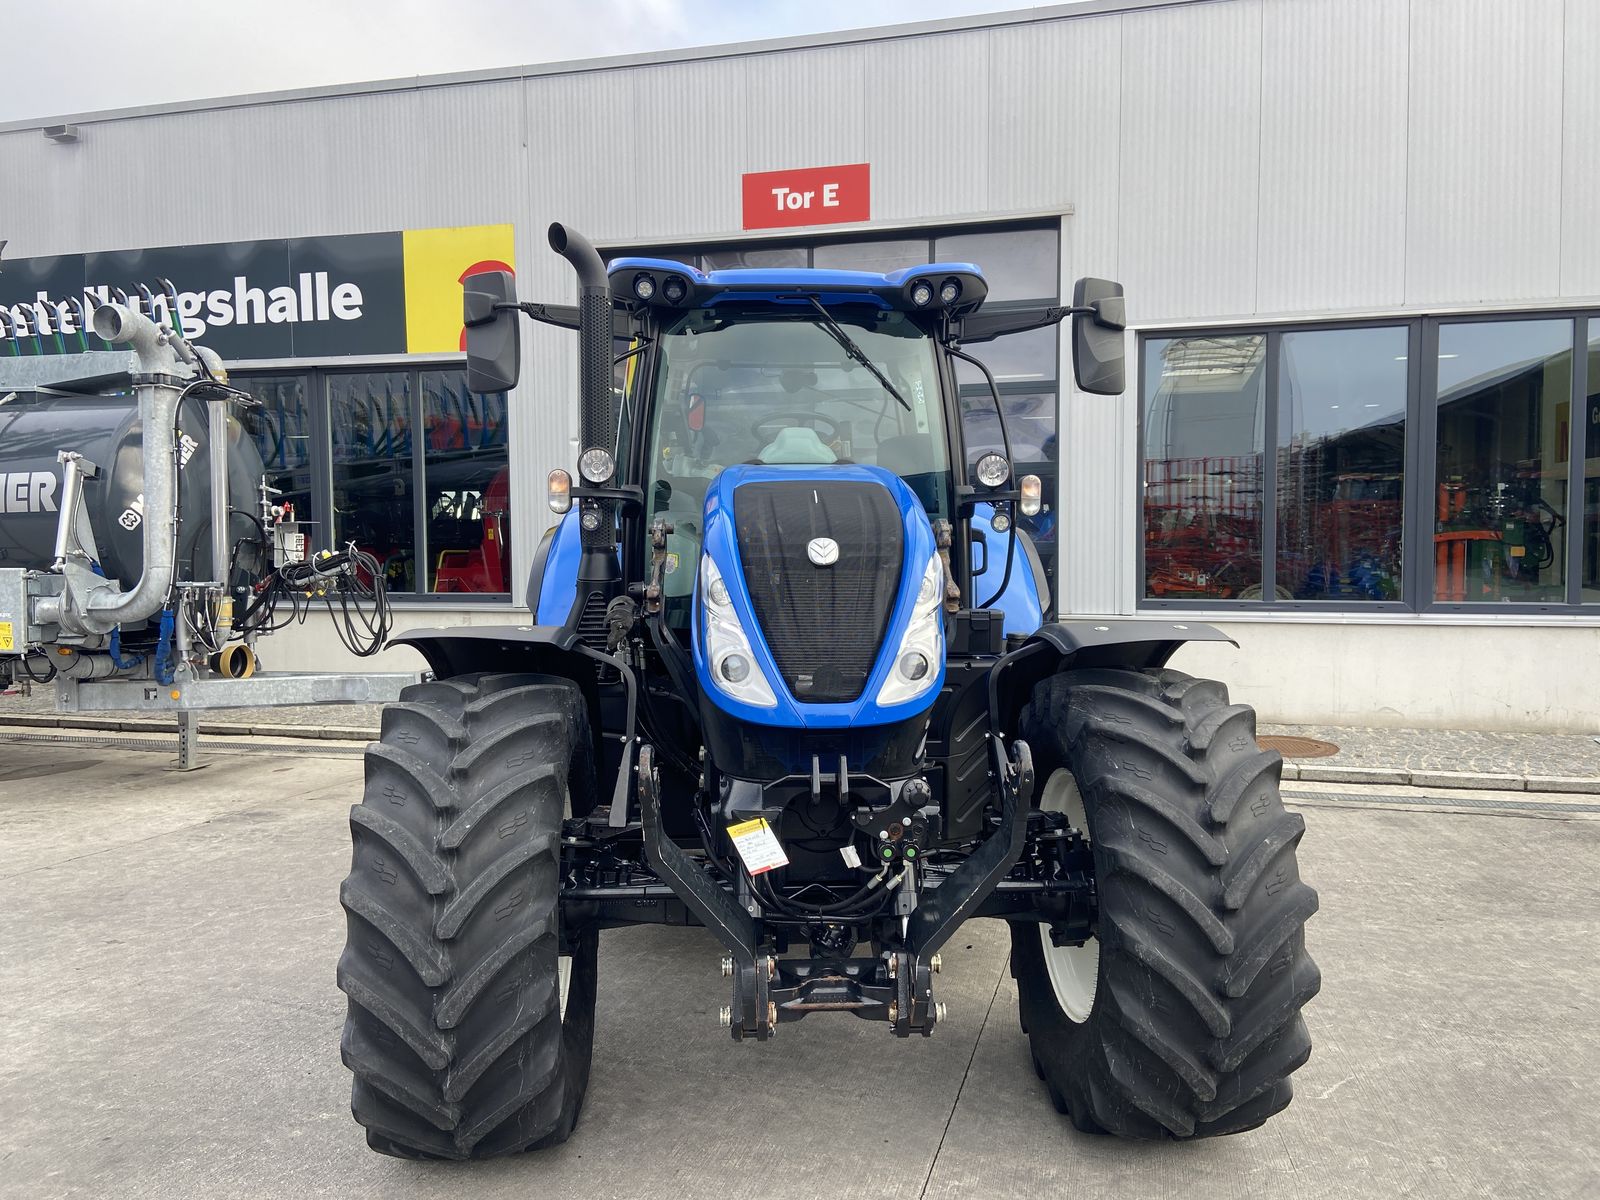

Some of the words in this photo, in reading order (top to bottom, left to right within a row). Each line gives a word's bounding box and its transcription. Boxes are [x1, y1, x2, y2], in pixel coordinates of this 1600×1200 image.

[772, 187, 814, 211] Tor
[823, 183, 839, 207] E
[0, 271, 364, 340] stelngshalle
